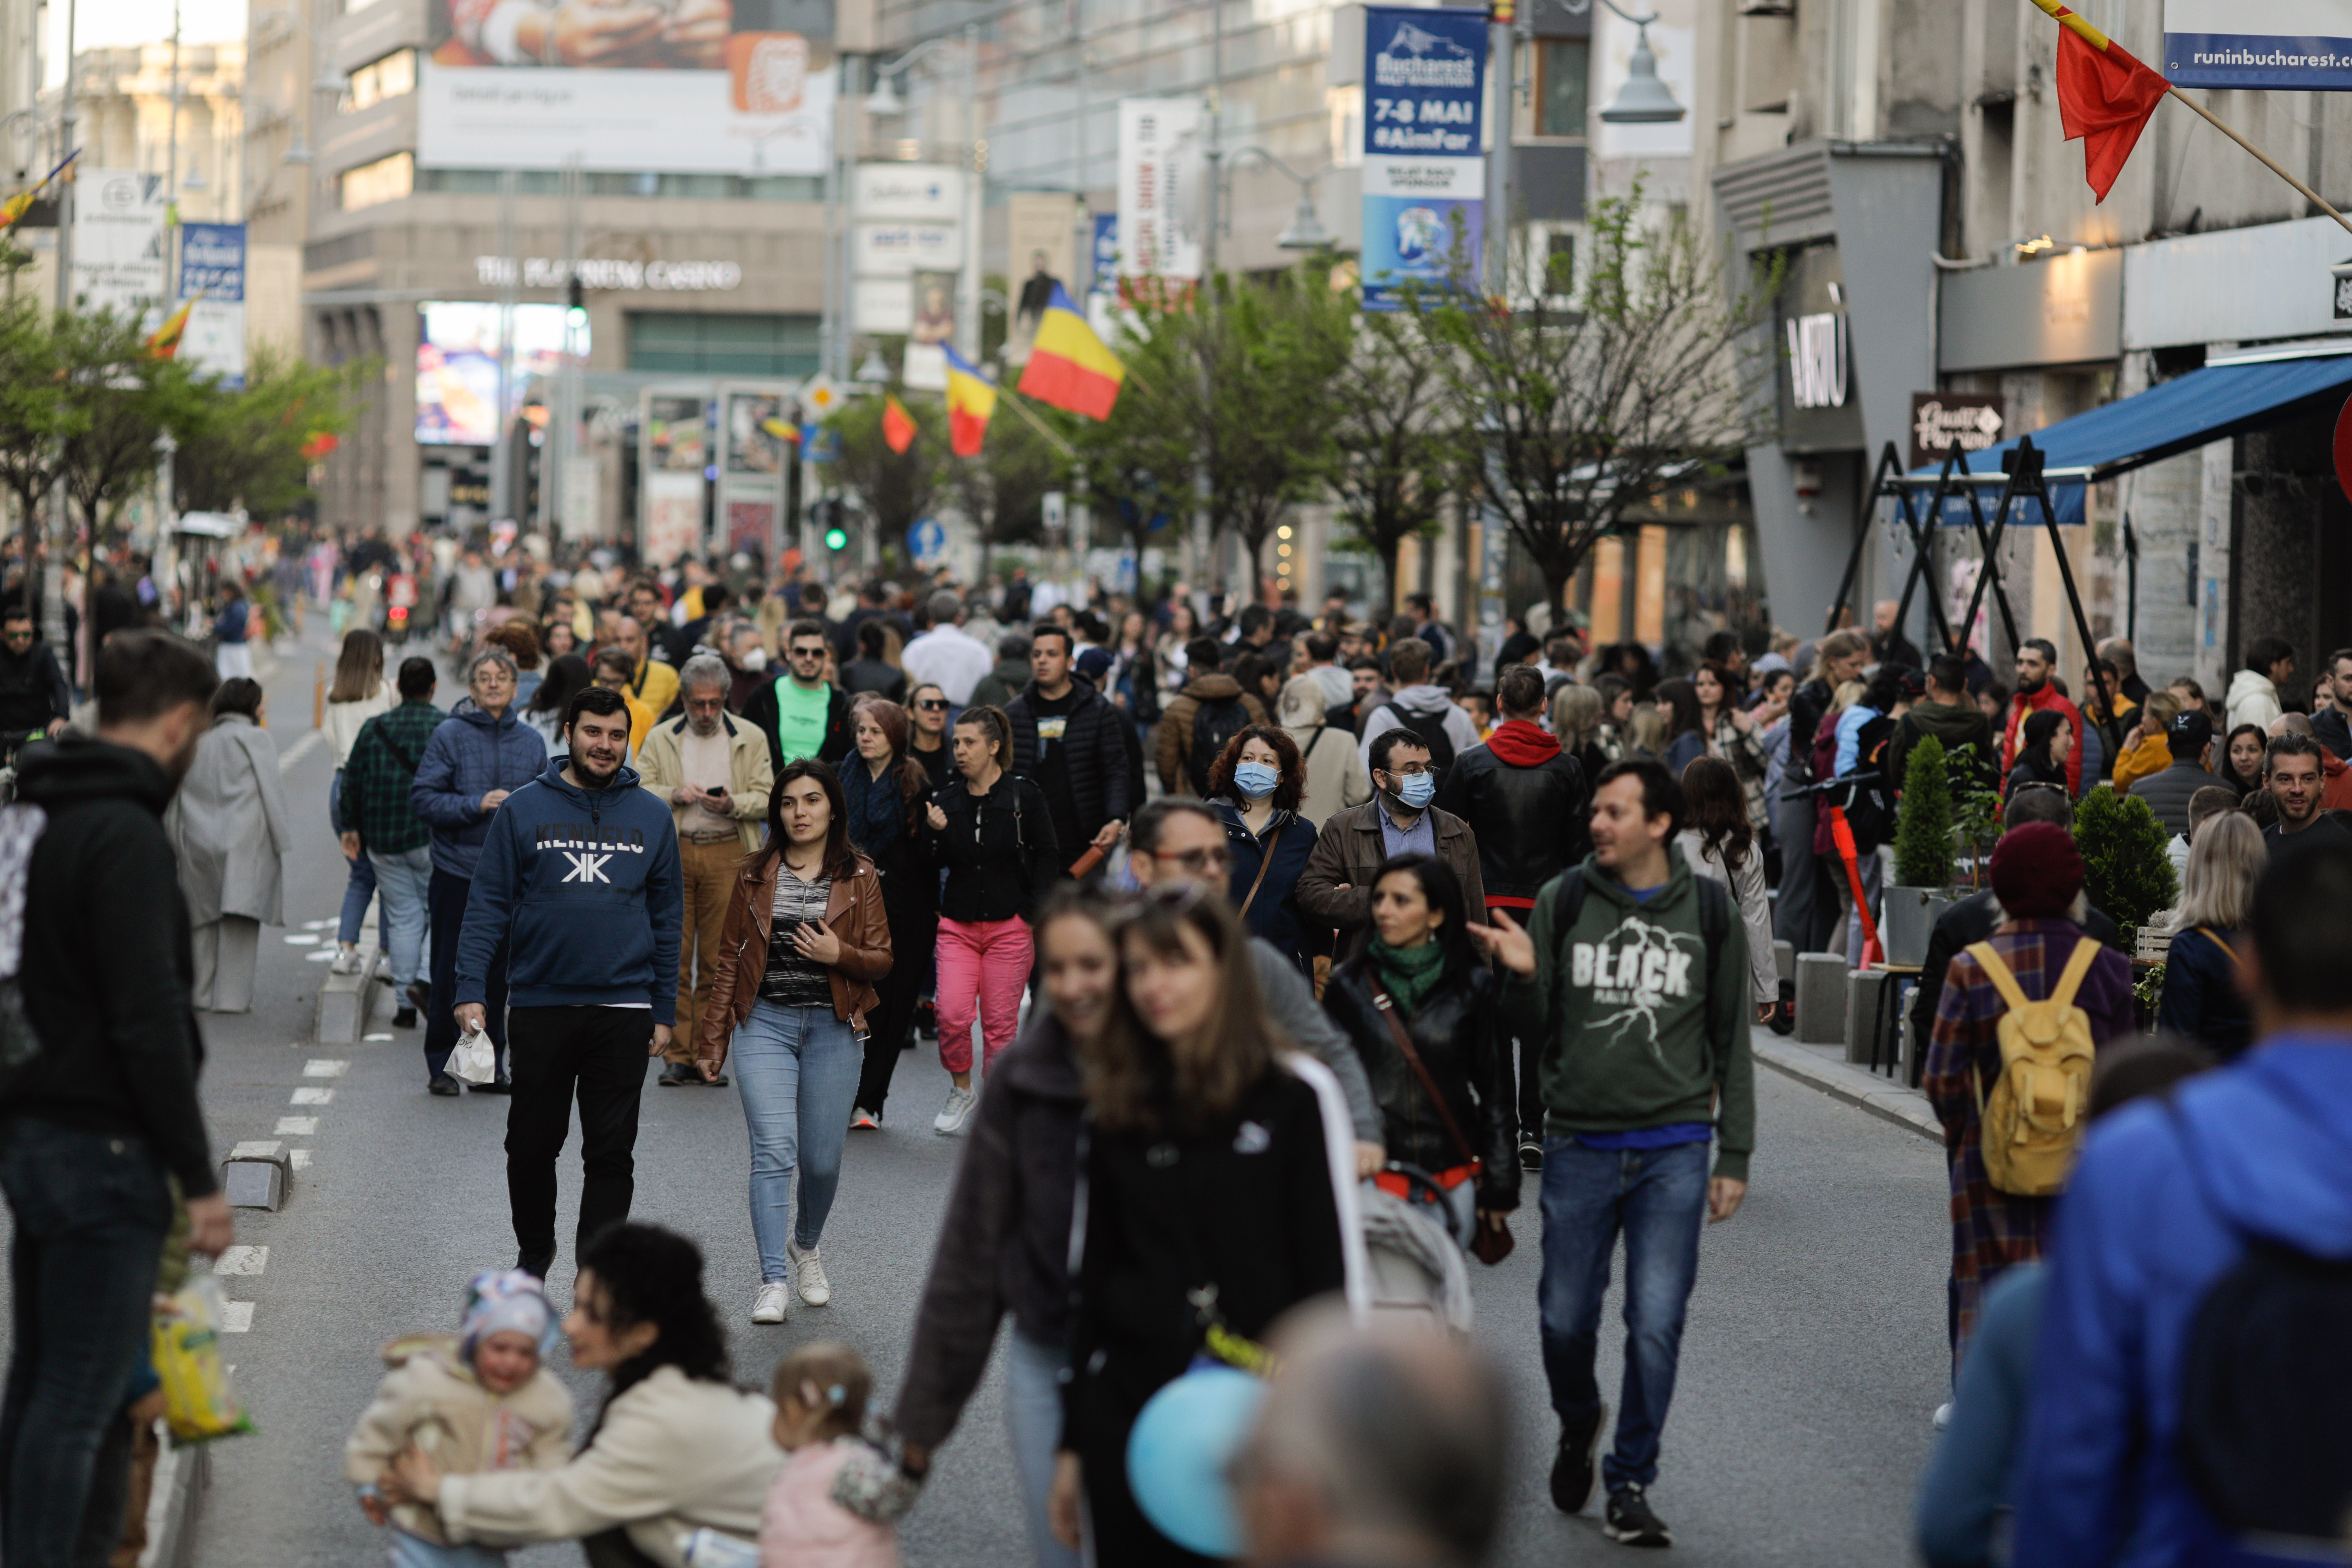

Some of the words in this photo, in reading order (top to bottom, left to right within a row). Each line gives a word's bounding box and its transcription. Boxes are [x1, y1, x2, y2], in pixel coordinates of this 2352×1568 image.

[1376, 52, 1475, 73] Bucharest
[1374, 98, 1415, 123] 7-8
[1419, 100, 1474, 124] MAI
[1374, 126, 1472, 151] #AimFor
[644, 259, 742, 291] CASINO
[537, 823, 643, 854] KENVELO
[1572, 942, 1692, 997] BLACK
